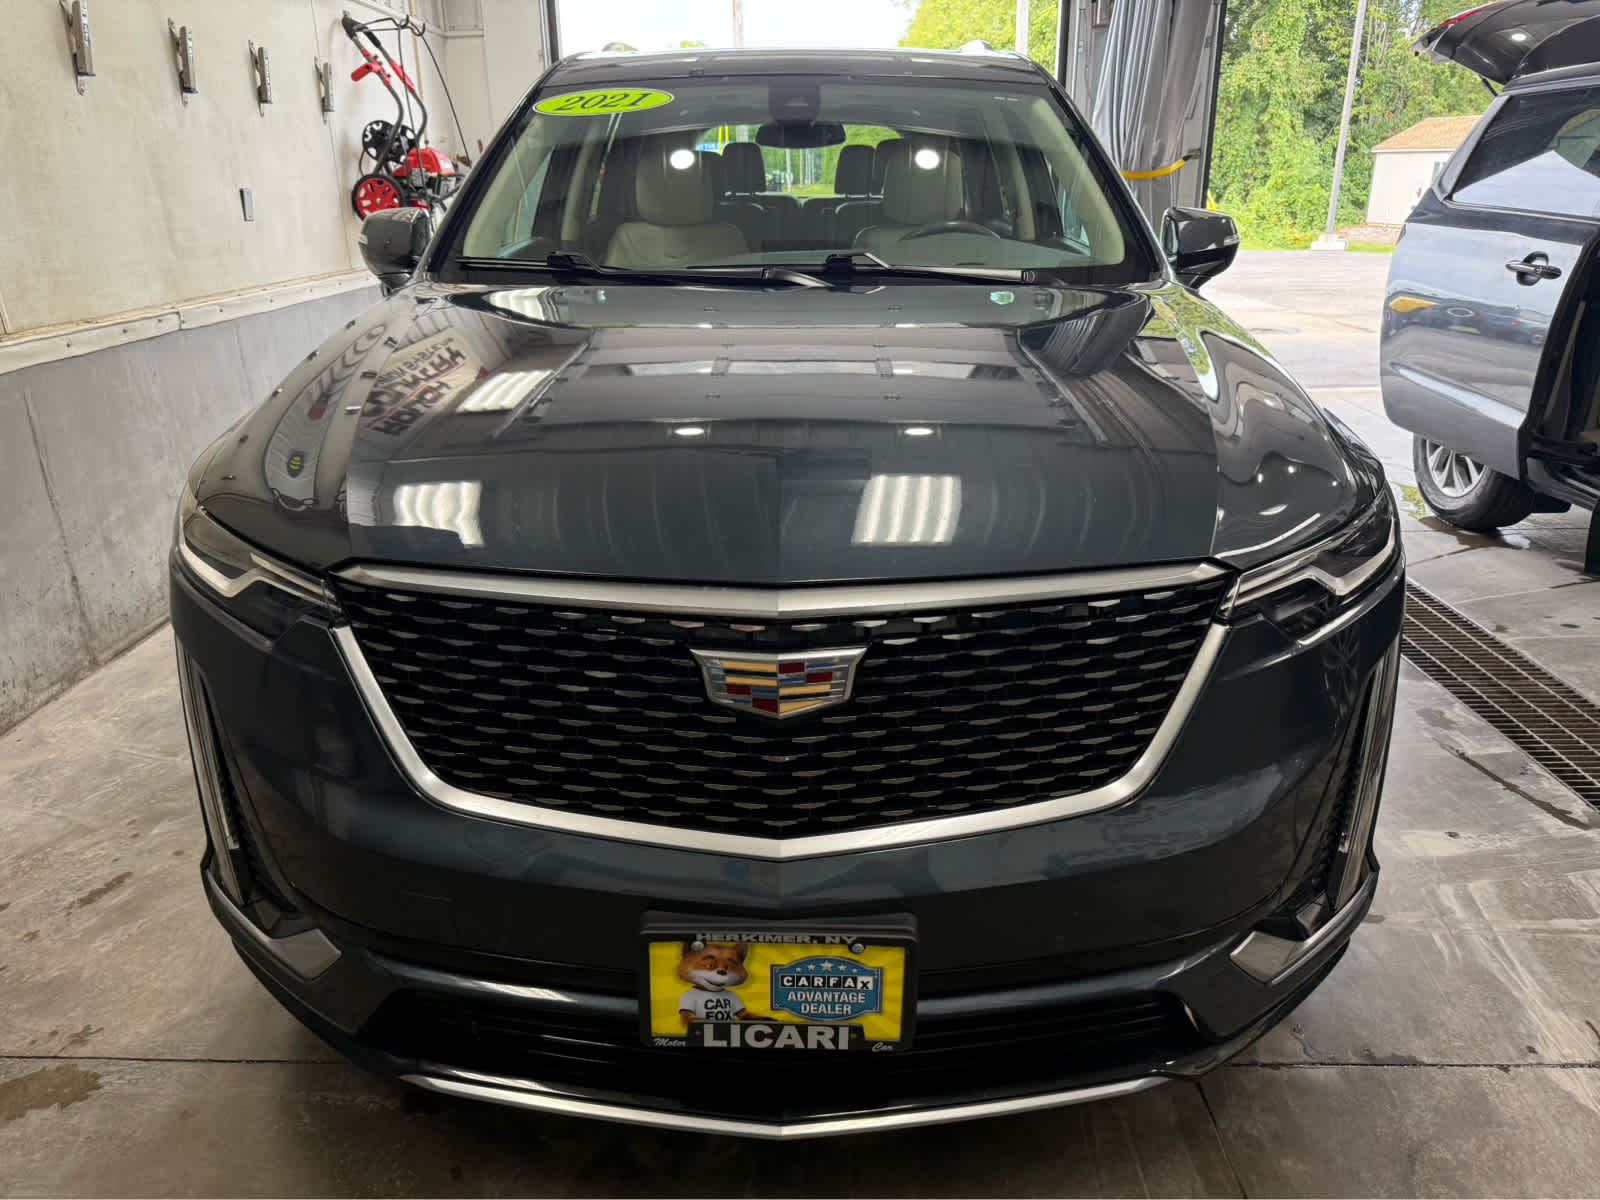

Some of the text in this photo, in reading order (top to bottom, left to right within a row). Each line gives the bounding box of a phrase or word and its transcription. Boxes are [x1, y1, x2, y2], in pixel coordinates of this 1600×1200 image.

[554, 92, 653, 112] 2021
[824, 935, 859, 945] NY
[782, 975, 871, 990] CARFAX
[787, 991, 866, 1004] ADVANTAGE
[704, 998, 731, 1010] CAR
[800, 1003, 853, 1015] DEALER
[705, 1010, 733, 1021] FOX
[703, 1024, 849, 1050] LICARI
